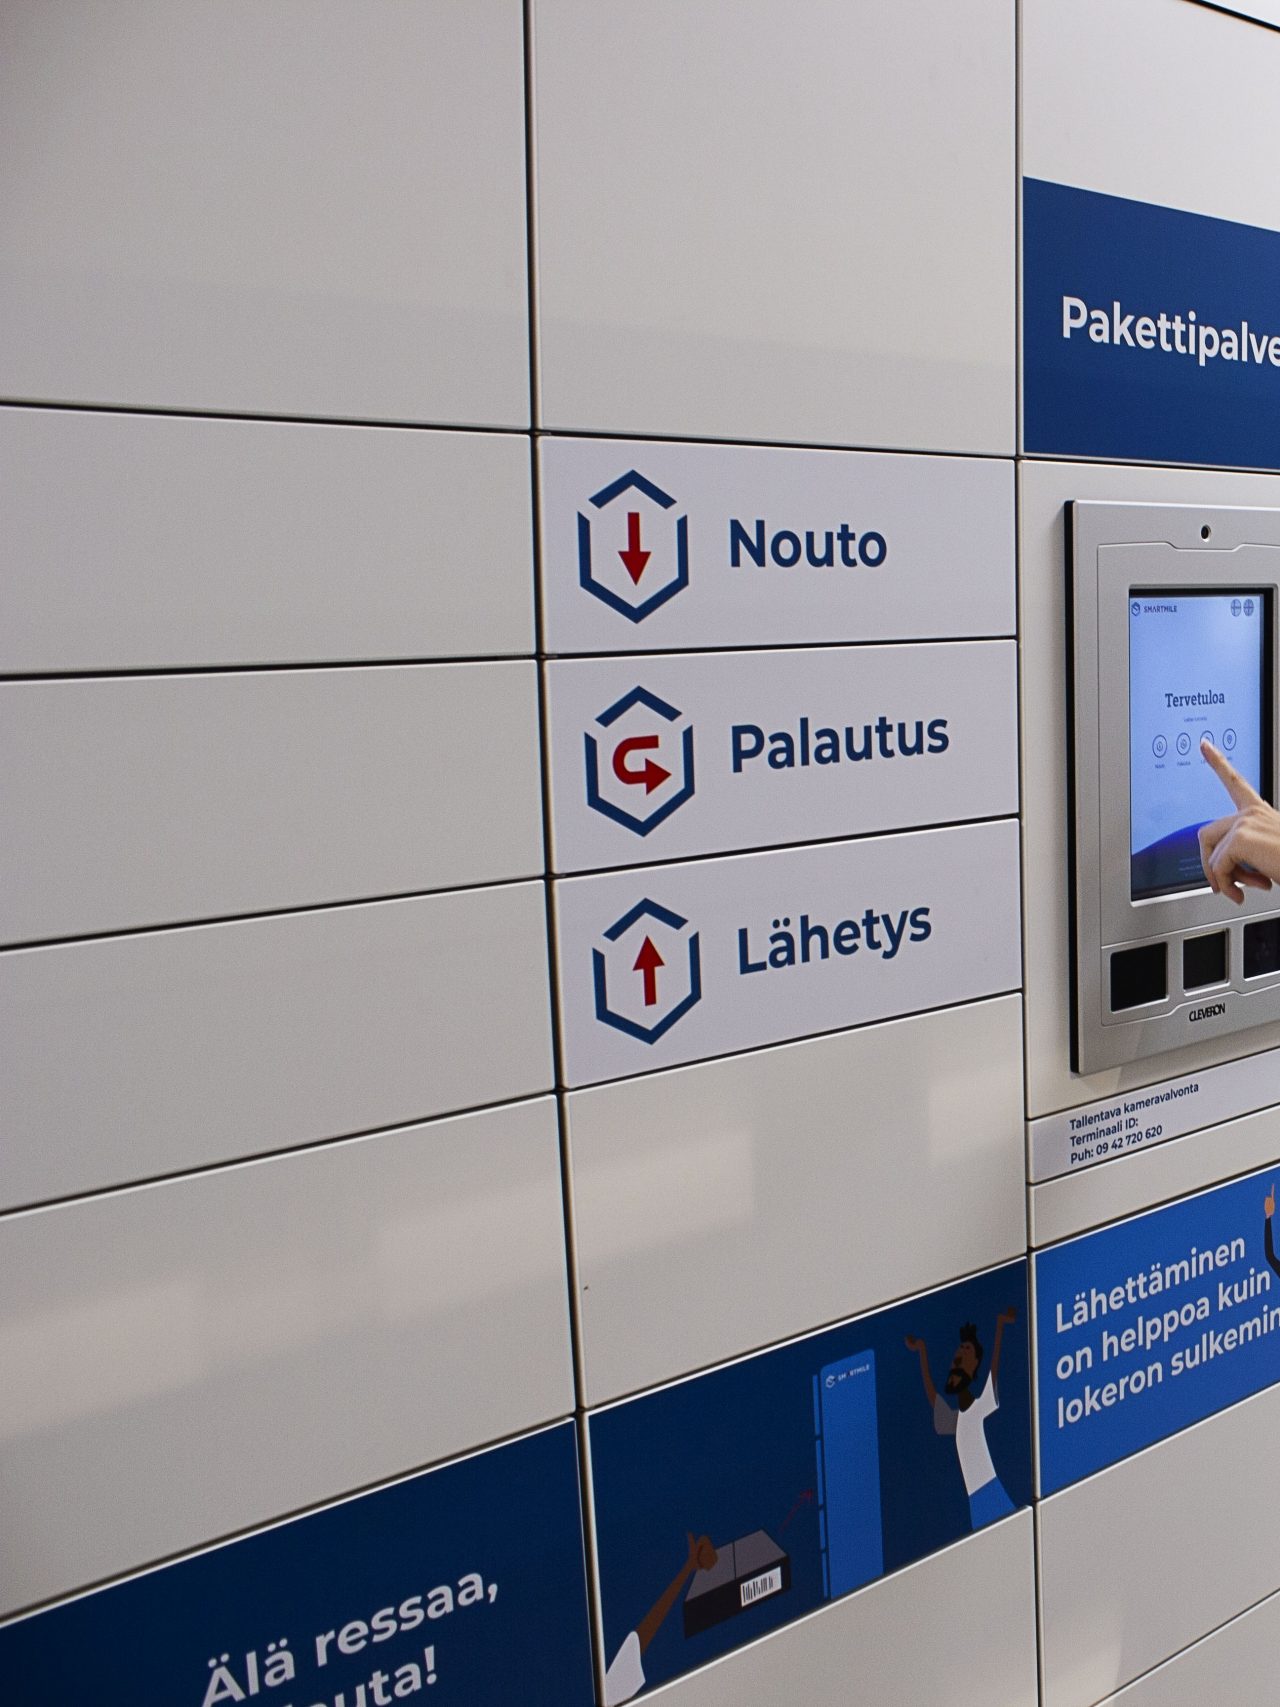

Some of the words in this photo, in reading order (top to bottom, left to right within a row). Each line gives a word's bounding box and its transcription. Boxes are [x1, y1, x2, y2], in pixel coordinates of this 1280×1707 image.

[729, 519, 888, 568] Nouto
[1143, 605, 1178, 613] SMARTMILE
[1165, 689, 1225, 708] Tervetuloa
[731, 716, 949, 773] Palautus
[738, 906, 932, 975] Lähetys
[1188, 1003, 1226, 1022] CLEVERON
[1070, 1107, 1121, 1131] Tallentava
[1124, 1083, 1199, 1115] kameravalvonta
[1070, 1120, 1123, 1148] Terminaali
[1125, 1117, 1139, 1131] ID:
[1070, 1147, 1094, 1164] Puh:
[1096, 1142, 1108, 1156] 09
[1111, 1138, 1123, 1150] 42
[1125, 1131, 1143, 1147] 720
[1145, 1125, 1162, 1140] 620
[1056, 1237, 1245, 1333] Lähettäminen
[1056, 1346, 1092, 1380] on
[1102, 1297, 1210, 1361] helppoa
[1218, 1267, 1270, 1311] kuin
[1057, 1362, 1163, 1429] lokeron
[202, 1638, 295, 1707] Älä
[315, 1571, 498, 1667] ressaa,
